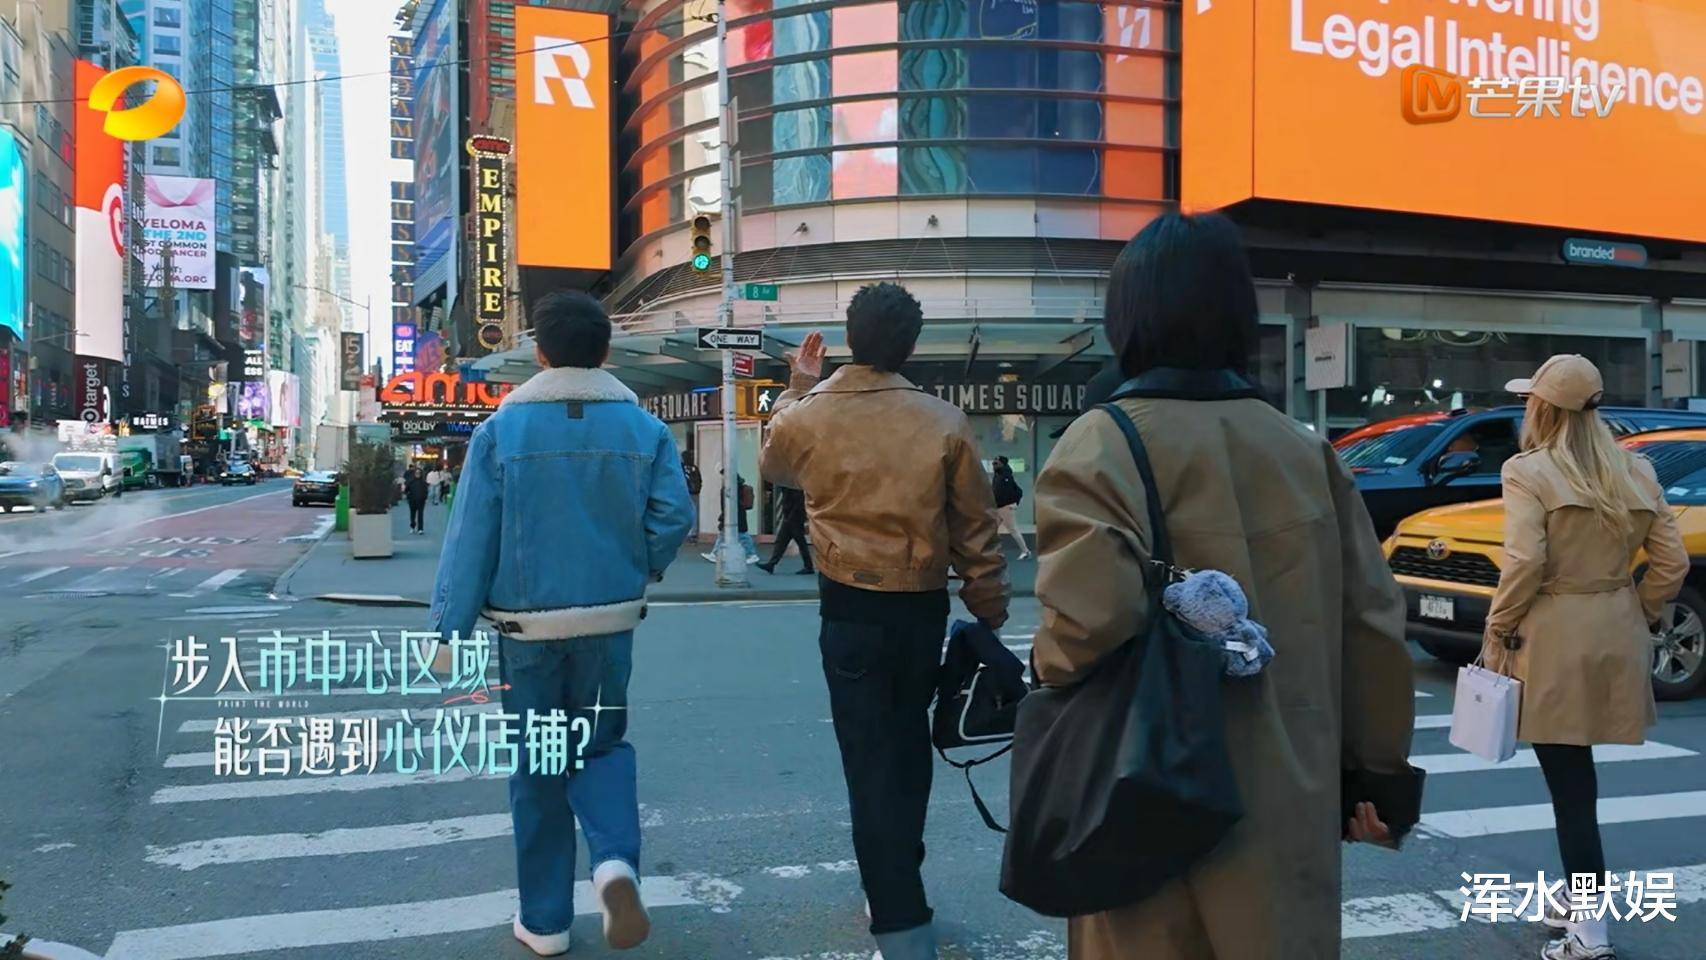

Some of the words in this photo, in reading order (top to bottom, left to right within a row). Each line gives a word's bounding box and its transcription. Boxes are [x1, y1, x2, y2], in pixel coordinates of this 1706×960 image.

[1291, 0, 1434, 77] Legal
[1446, 19, 1704, 114] Intelligence
[142, 219, 206, 231] YELOMA
[177, 230, 206, 241] 2ND
[481, 168, 502, 312] EMPIRE
[159, 240, 207, 249] COMMON
[173, 249, 207, 257] ANCER
[1570, 242, 1615, 260] branded
[752, 286, 759, 298] 8
[710, 334, 728, 344] ONE
[736, 335, 755, 344] WAY
[395, 340, 414, 352] EAT
[83, 363, 101, 407] target
[380, 371, 509, 404] amc
[935, 385, 1004, 410] TIMES
[1016, 384, 1088, 411] SQUAR
[661, 392, 707, 419] SQUARE
[403, 421, 436, 431] DOLBY
[447, 424, 473, 433] IMA
